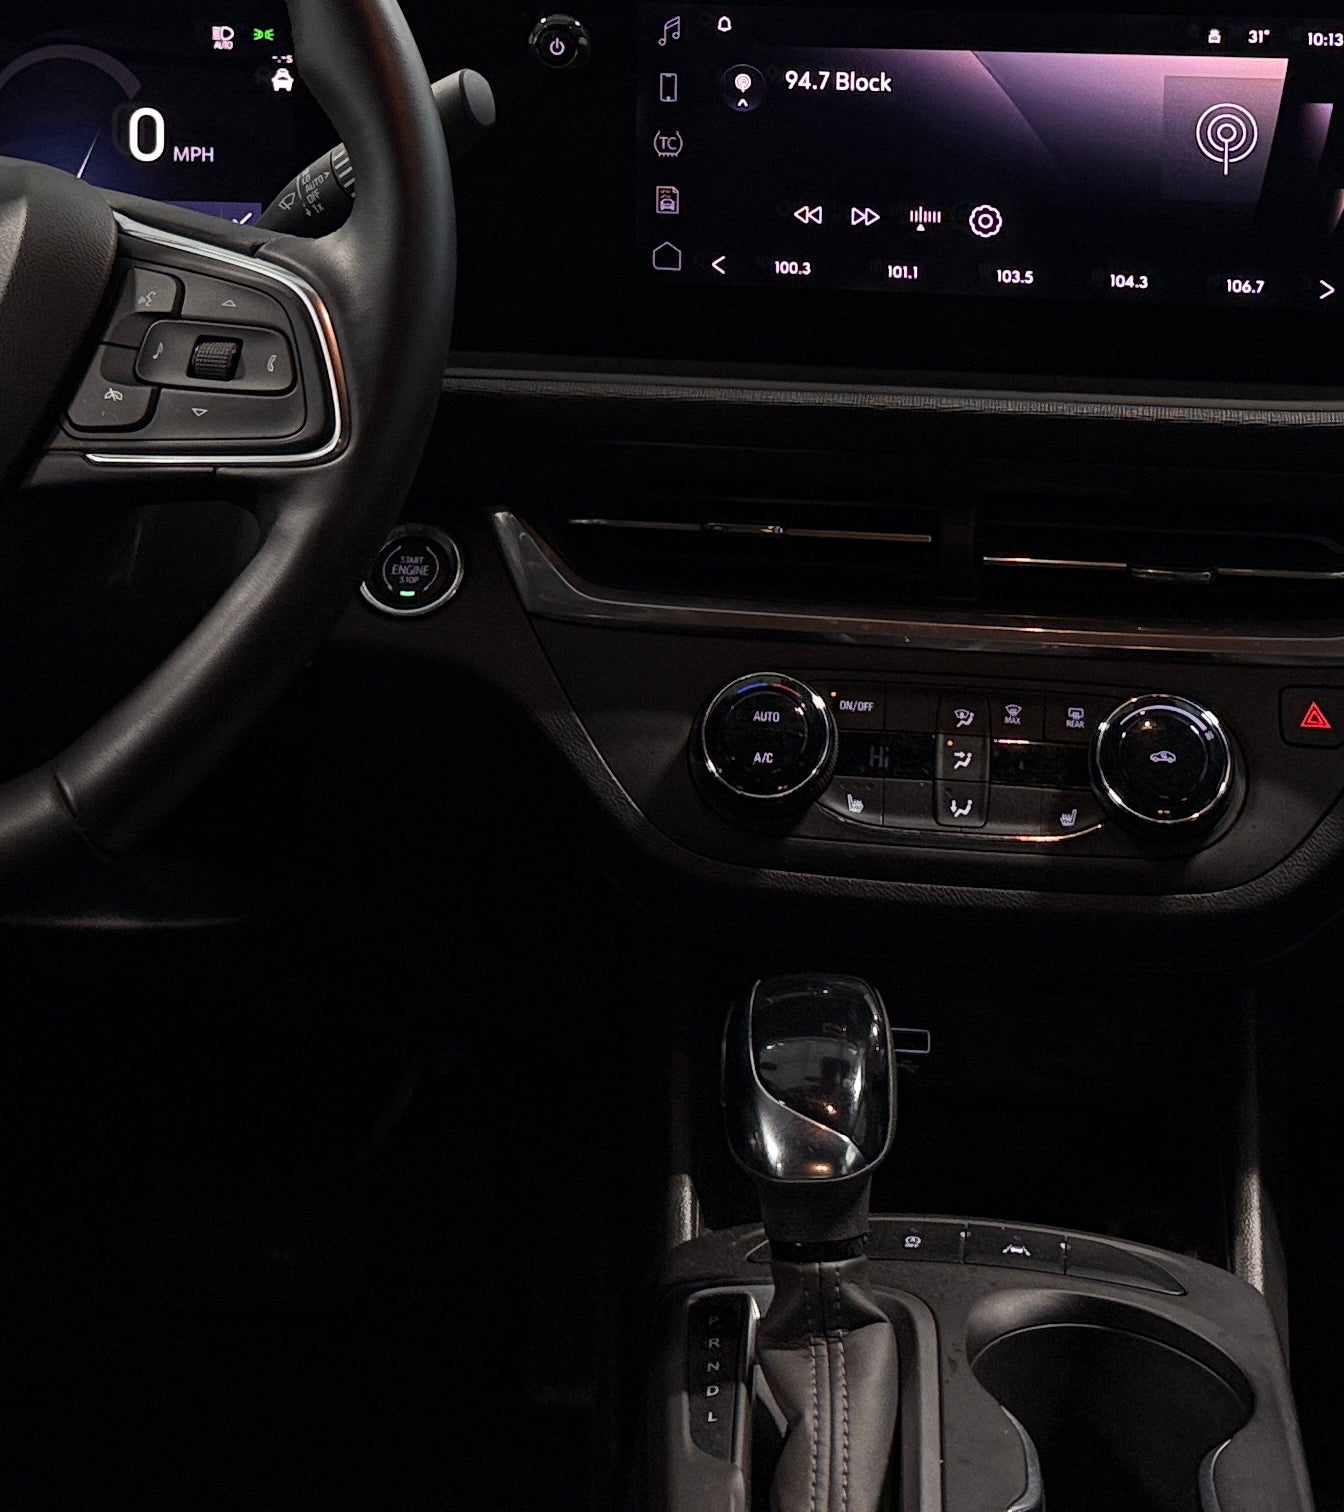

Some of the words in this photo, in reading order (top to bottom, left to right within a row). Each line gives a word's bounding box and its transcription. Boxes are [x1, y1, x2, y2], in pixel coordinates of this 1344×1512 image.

[1307, 31, 1344, 47] 10:13
[785, 70, 830, 91] 94.7
[836, 71, 893, 93] Block
[129, 107, 165, 163] 0
[659, 136, 677, 150] TC
[173, 146, 215, 163] MPH
[304, 174, 325, 194] AUTO
[306, 188, 320, 204] OFF
[774, 261, 811, 276] 100.3
[887, 264, 918, 279] 101.1
[997, 269, 1034, 284] 103.5
[1110, 274, 1148, 289] 104.3
[1227, 279, 1265, 294] 106.7
[400, 556, 424, 564] START
[391, 565, 430, 575] ENGINE
[399, 575, 420, 584] STOP
[839, 699, 875, 712] ON/OFF
[753, 711, 781, 723] AUTO
[1004, 716, 1022, 726] MAX
[1065, 719, 1086, 729] REAR
[753, 752, 774, 764] A/C
[708, 1337, 721, 1349] R
[707, 1361, 721, 1373] N
[706, 1385, 720, 1397] D
[707, 1411, 718, 1423] L
